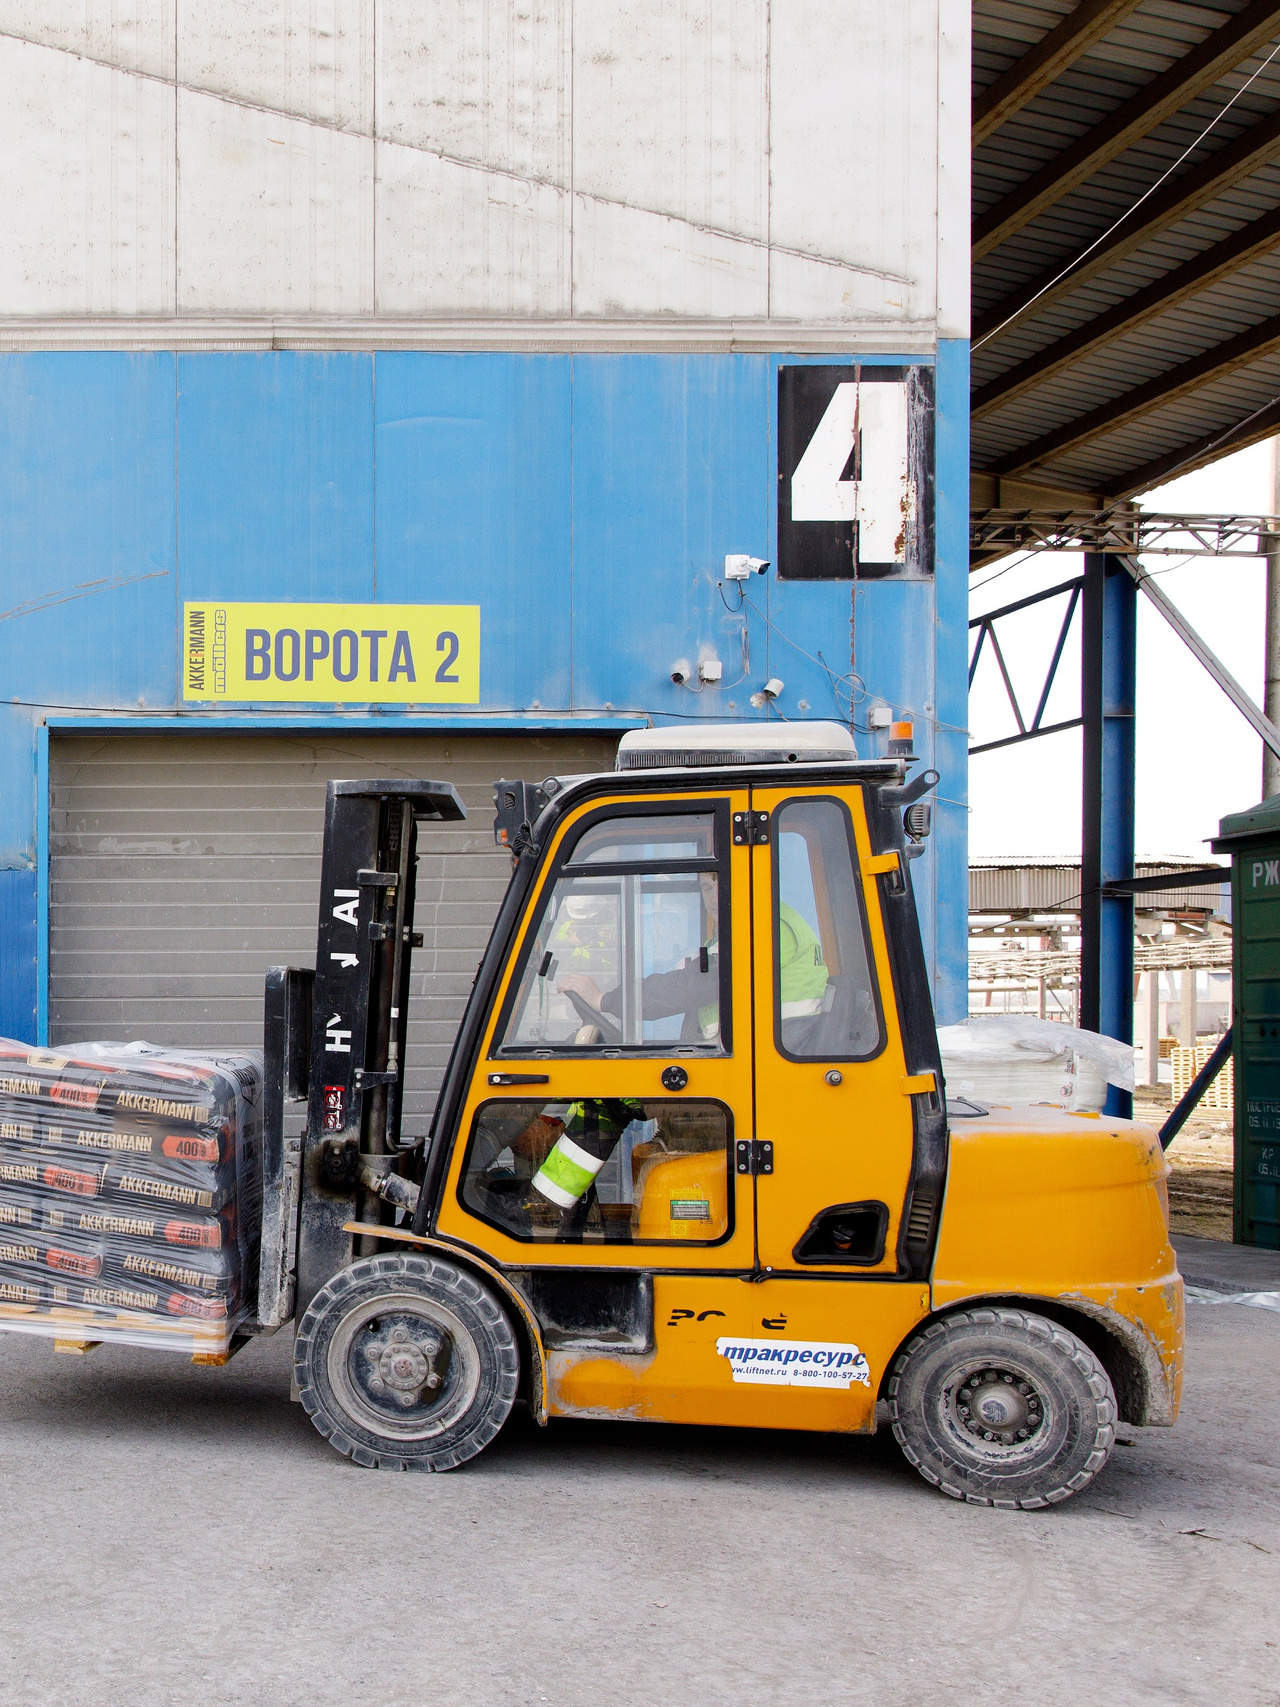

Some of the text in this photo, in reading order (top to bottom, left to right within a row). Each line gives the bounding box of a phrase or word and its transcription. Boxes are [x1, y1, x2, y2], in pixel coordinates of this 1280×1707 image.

[791, 382, 917, 564] 4
[188, 610, 205, 691] AKKERMANN
[245, 628, 460, 683] ВОРОТА 2
[117, 1090, 193, 1121] AKKERMANN
[77, 1130, 153, 1152] AKKERMANN
[176, 1140, 199, 1157] 400
[119, 1175, 196, 1205] AKKERMANN
[79, 1213, 155, 1237] AKKERMANN
[178, 1226, 201, 1243] 400
[123, 1254, 201, 1287] AKKERMANN
[83, 1288, 159, 1309] AKKERMANN
[723, 1346, 866, 1368] тракресурс
